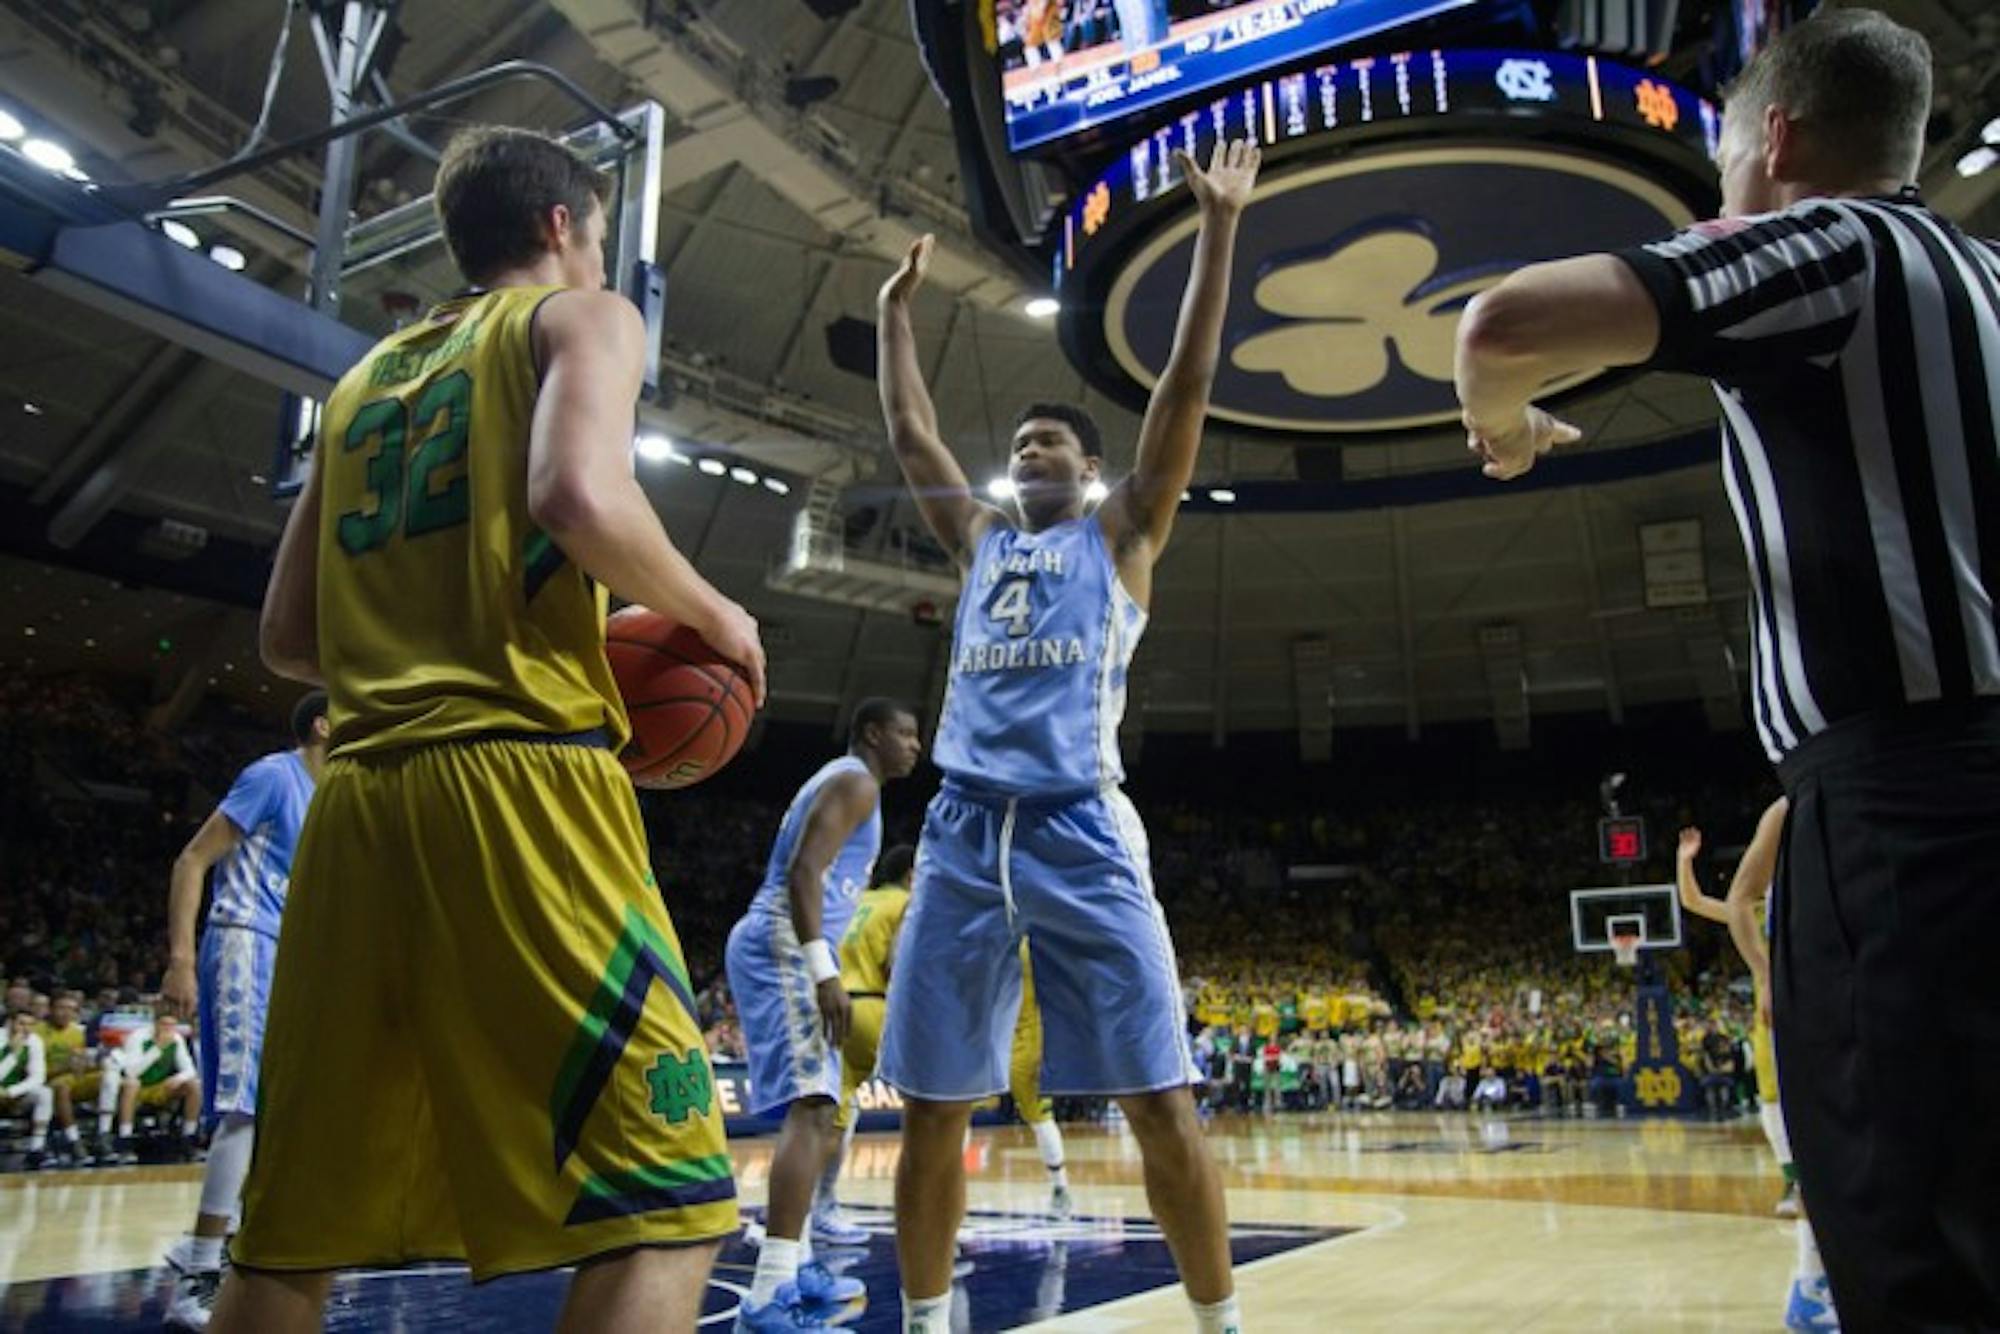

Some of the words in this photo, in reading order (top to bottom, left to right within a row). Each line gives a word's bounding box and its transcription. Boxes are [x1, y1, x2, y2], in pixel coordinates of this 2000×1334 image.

[338, 368, 474, 557] 32
[981, 548, 1064, 586] NRTH
[988, 577, 1032, 638] 4
[958, 637, 1086, 673] AROLINA
[856, 1079, 905, 1109] BAL
